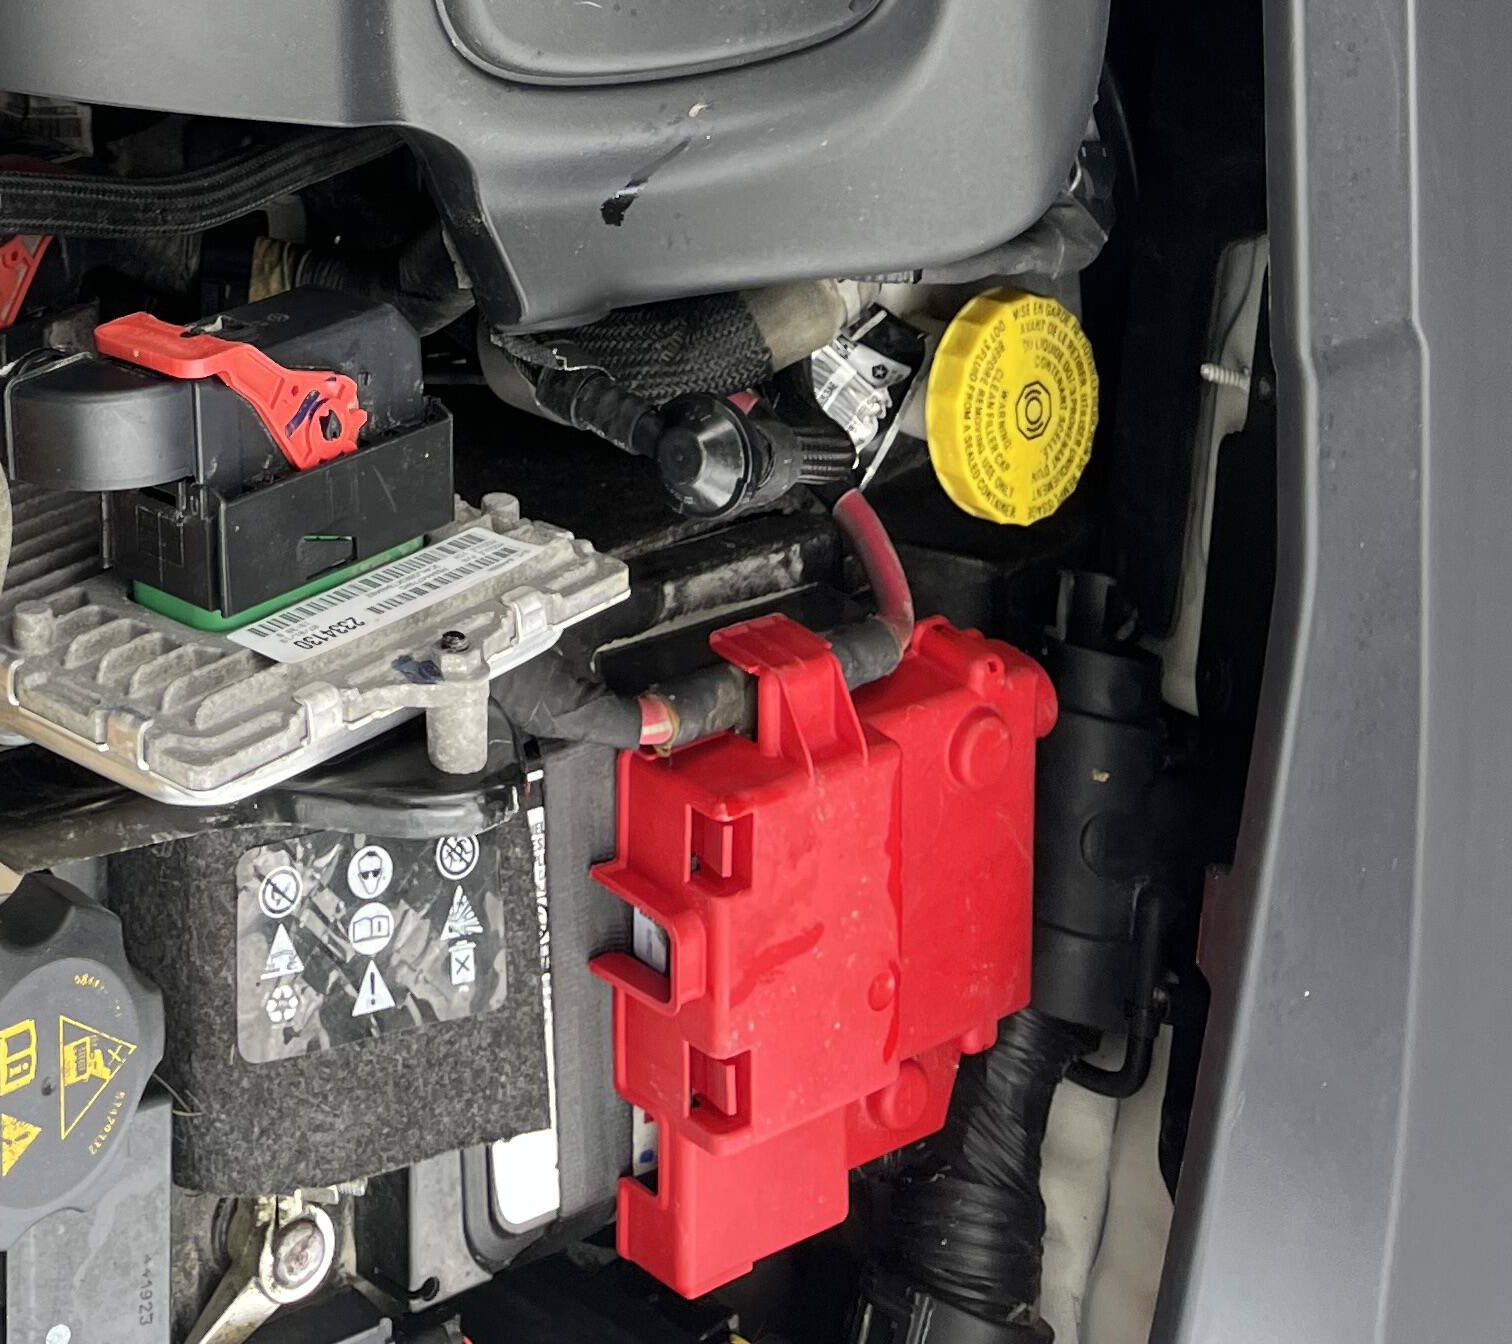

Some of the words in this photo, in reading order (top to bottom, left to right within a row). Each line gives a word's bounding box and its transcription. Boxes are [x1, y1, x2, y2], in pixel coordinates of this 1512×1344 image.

[990, 320, 1006, 344] DOT
[963, 384, 975, 421] FROM
[986, 369, 1004, 409] CLEAN
[963, 424, 972, 433] A
[984, 413, 998, 452] FILLER
[293, 616, 366, 650] 2334130
